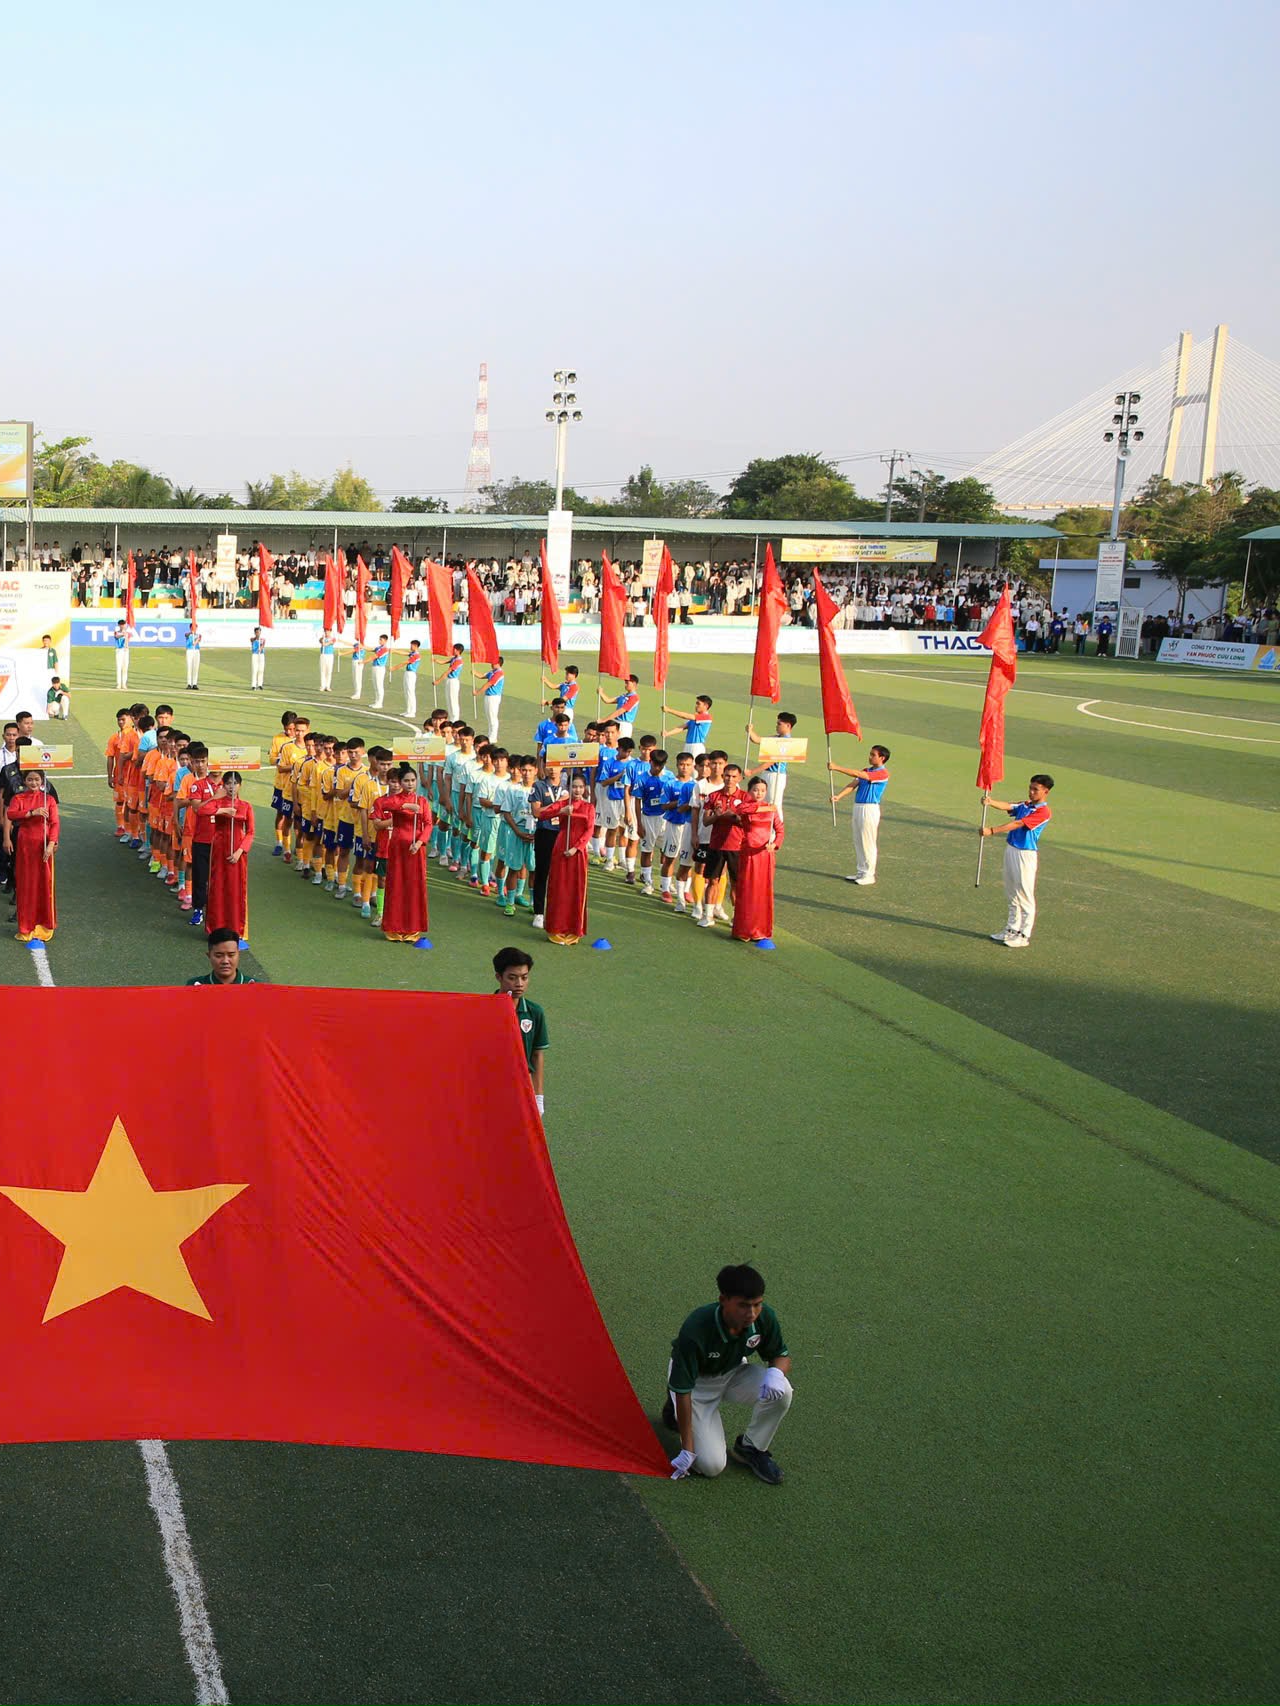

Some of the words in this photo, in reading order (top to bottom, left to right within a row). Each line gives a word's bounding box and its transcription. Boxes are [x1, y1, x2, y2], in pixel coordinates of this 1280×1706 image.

[917, 635, 993, 651] THAC
[282, 802, 291, 811] 20
[680, 850, 689, 860] 21
[697, 849, 707, 859] 23
